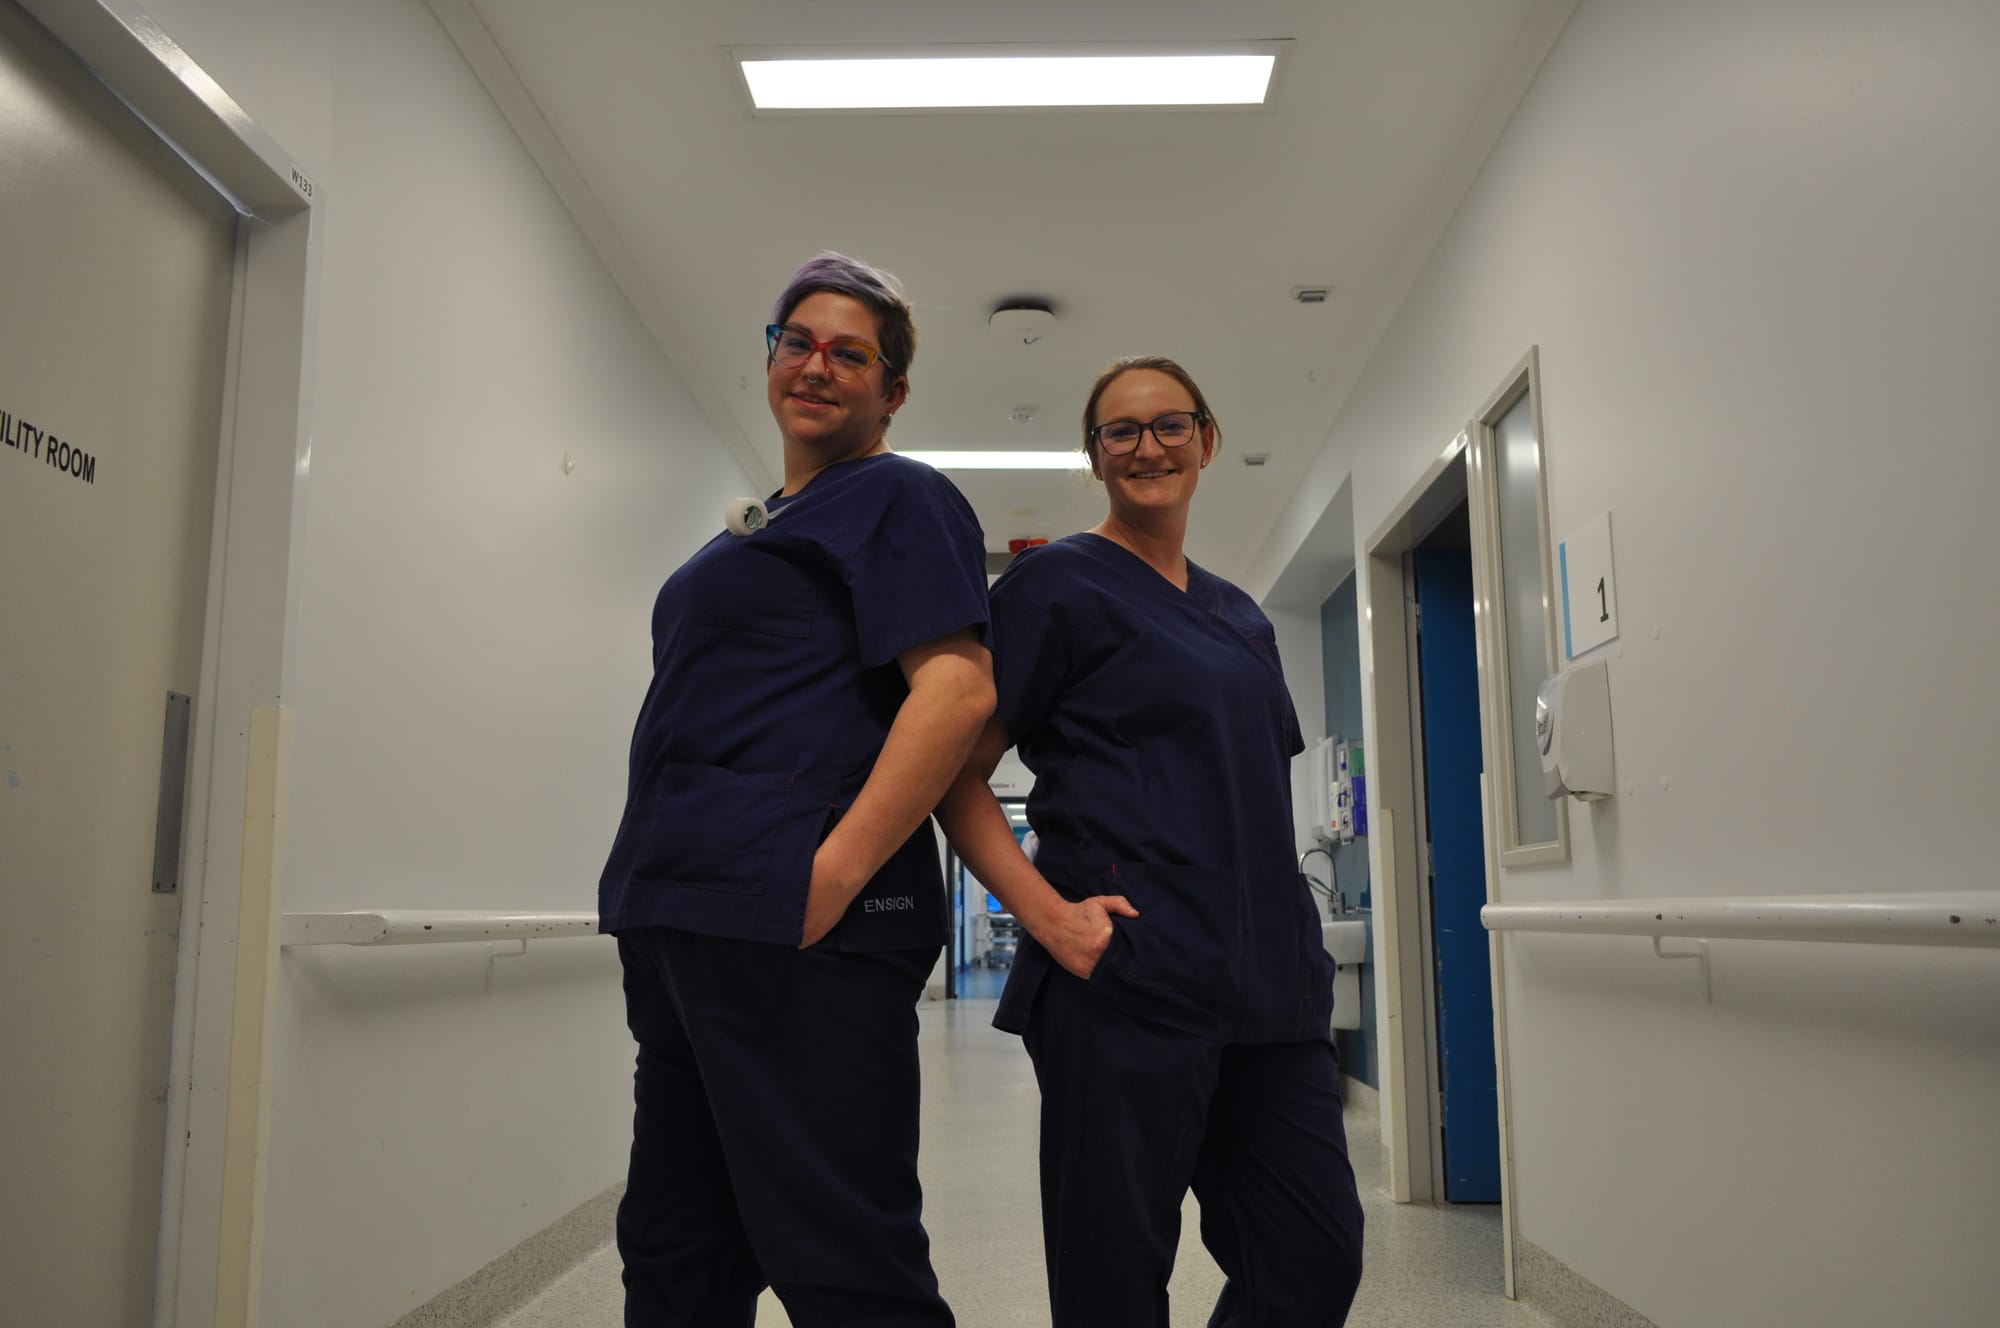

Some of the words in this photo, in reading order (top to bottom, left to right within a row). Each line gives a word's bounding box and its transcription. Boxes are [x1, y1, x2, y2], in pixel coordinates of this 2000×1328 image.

[291, 166, 313, 198] W133
[0, 409, 44, 459] ILITY
[46, 435, 96, 485] ROOM
[1597, 577, 1609, 623] 1
[864, 895, 915, 913] ENSIGN
